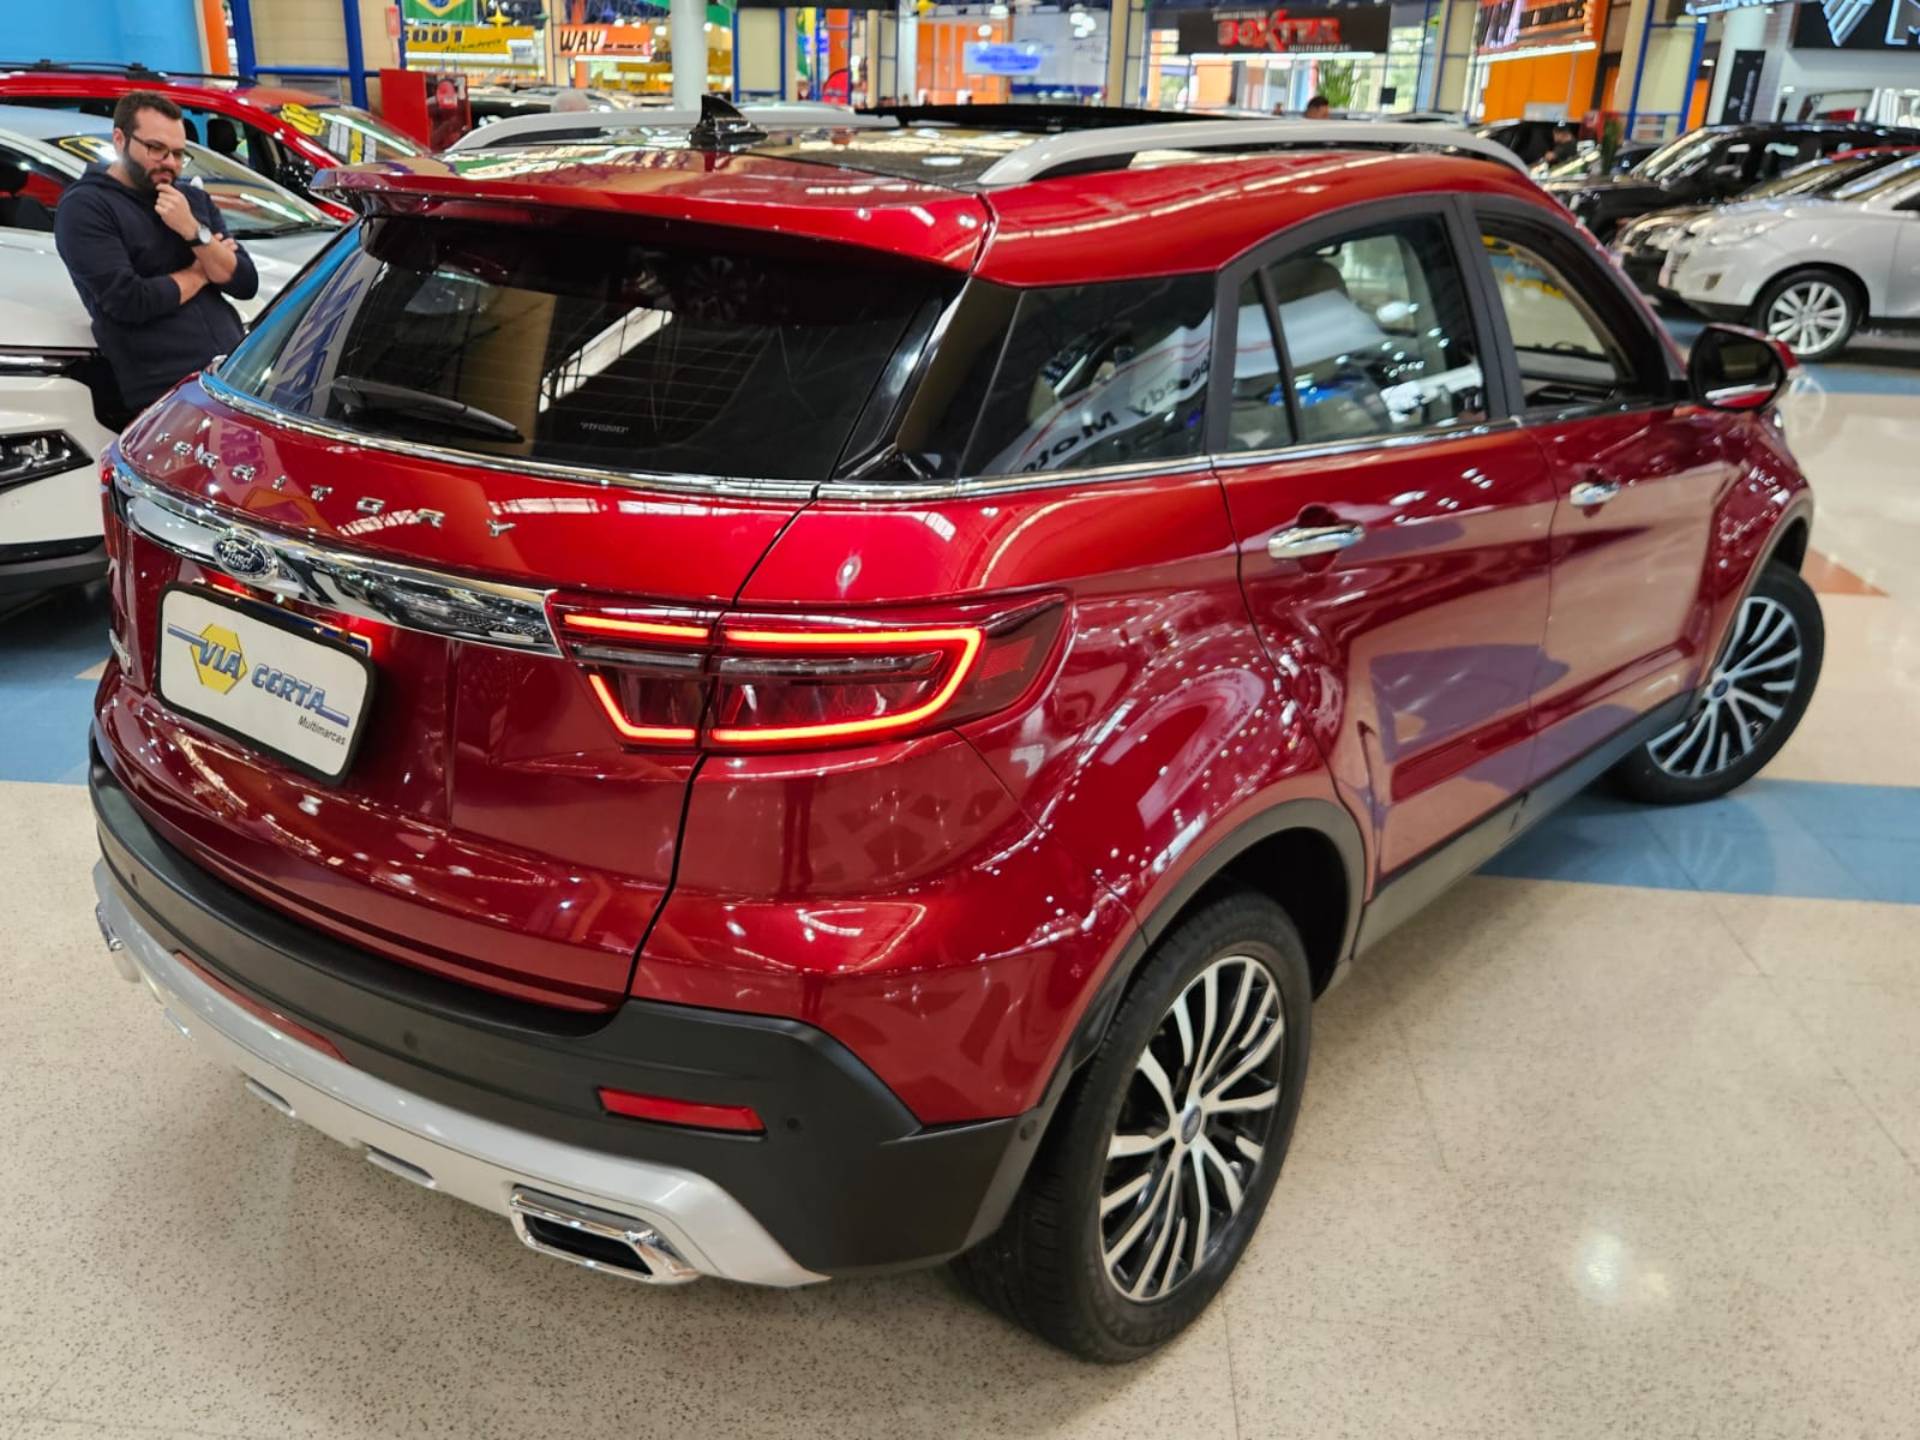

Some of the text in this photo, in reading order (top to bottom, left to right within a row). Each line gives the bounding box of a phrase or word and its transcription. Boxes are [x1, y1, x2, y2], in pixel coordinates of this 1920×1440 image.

[560, 30, 601, 52] WAY
[219, 540, 263, 572] Ford
[199, 640, 242, 681] VIA
[298, 715, 347, 746] Multimarcas
